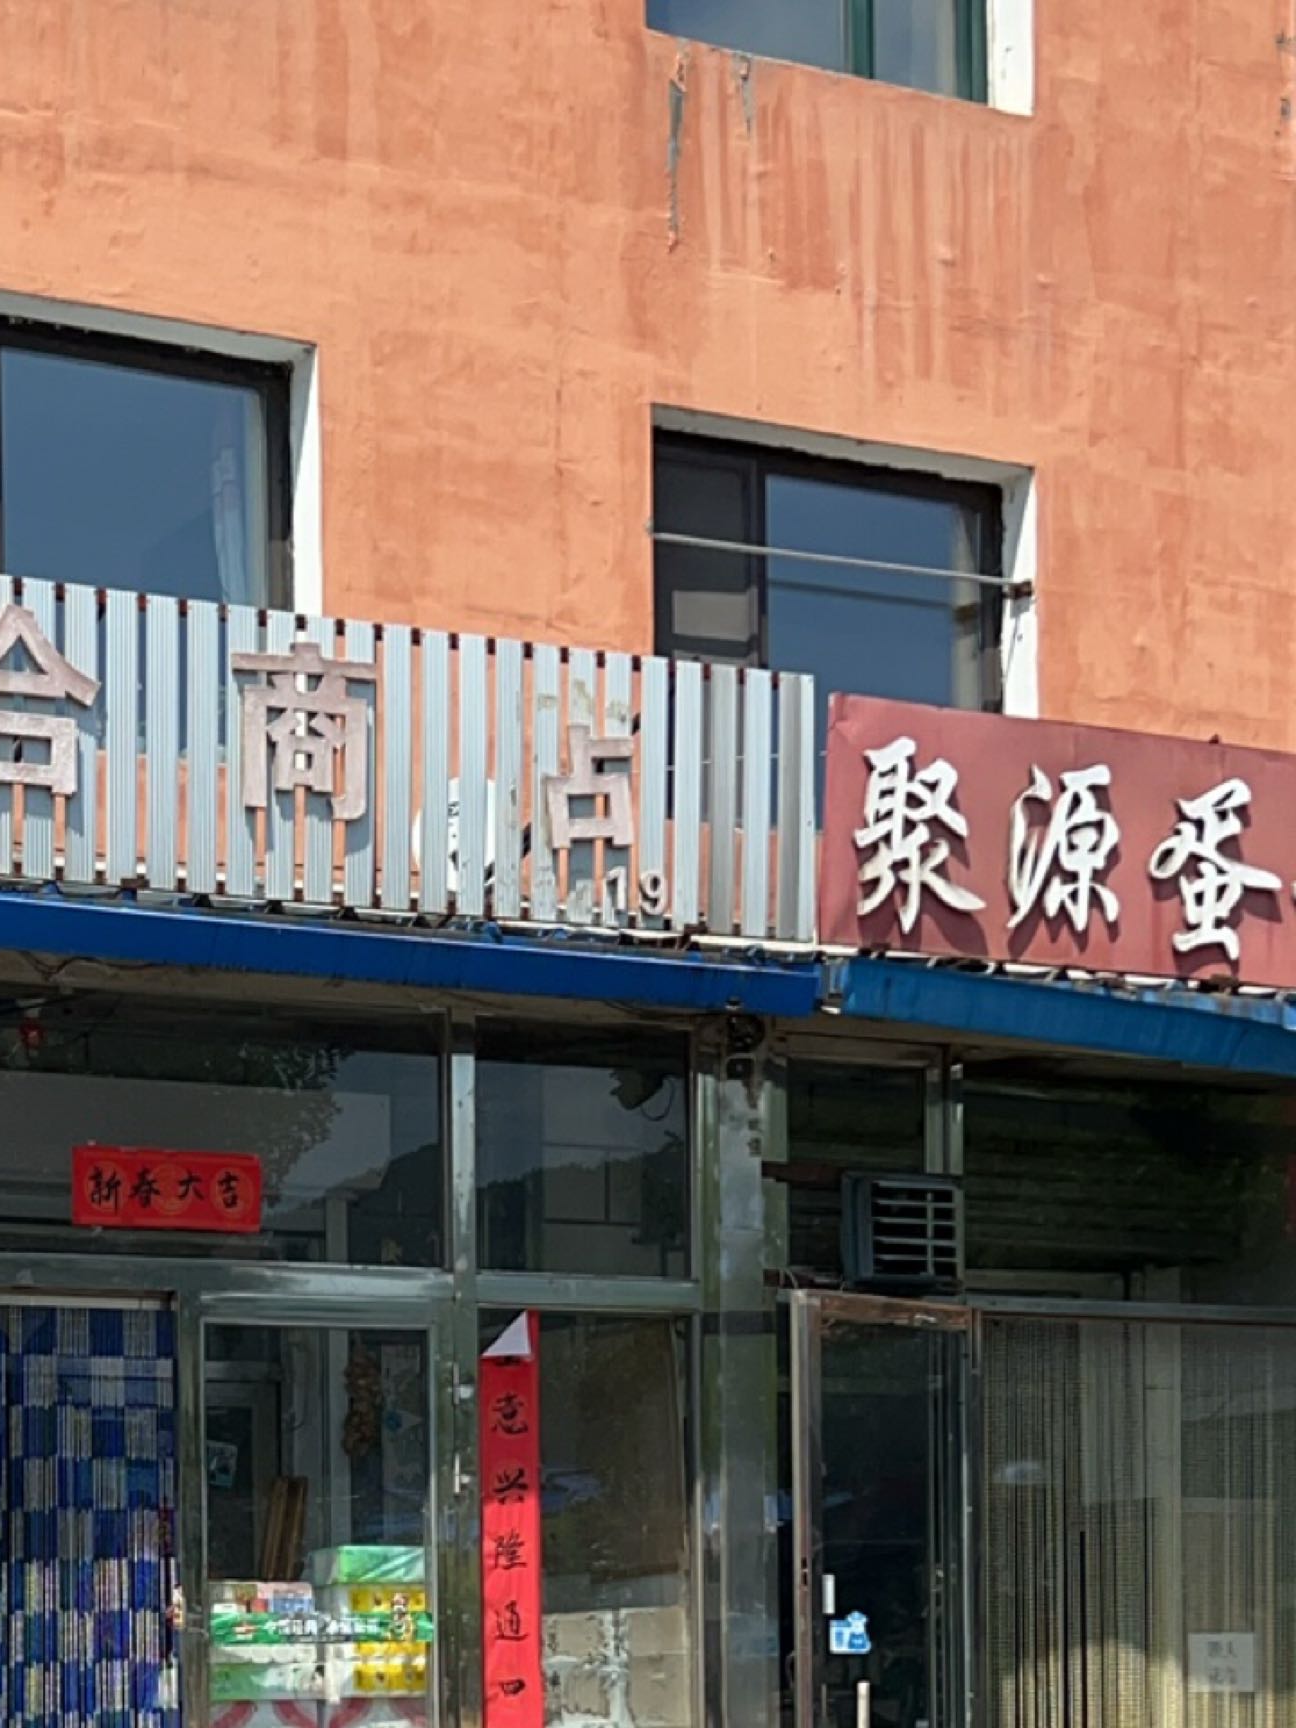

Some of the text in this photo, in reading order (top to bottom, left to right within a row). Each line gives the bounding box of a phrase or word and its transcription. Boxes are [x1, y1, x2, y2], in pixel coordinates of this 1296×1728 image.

[854, 736, 1296, 961] 聚源蛋
[88, 1166, 241, 1216] 新春大吉
